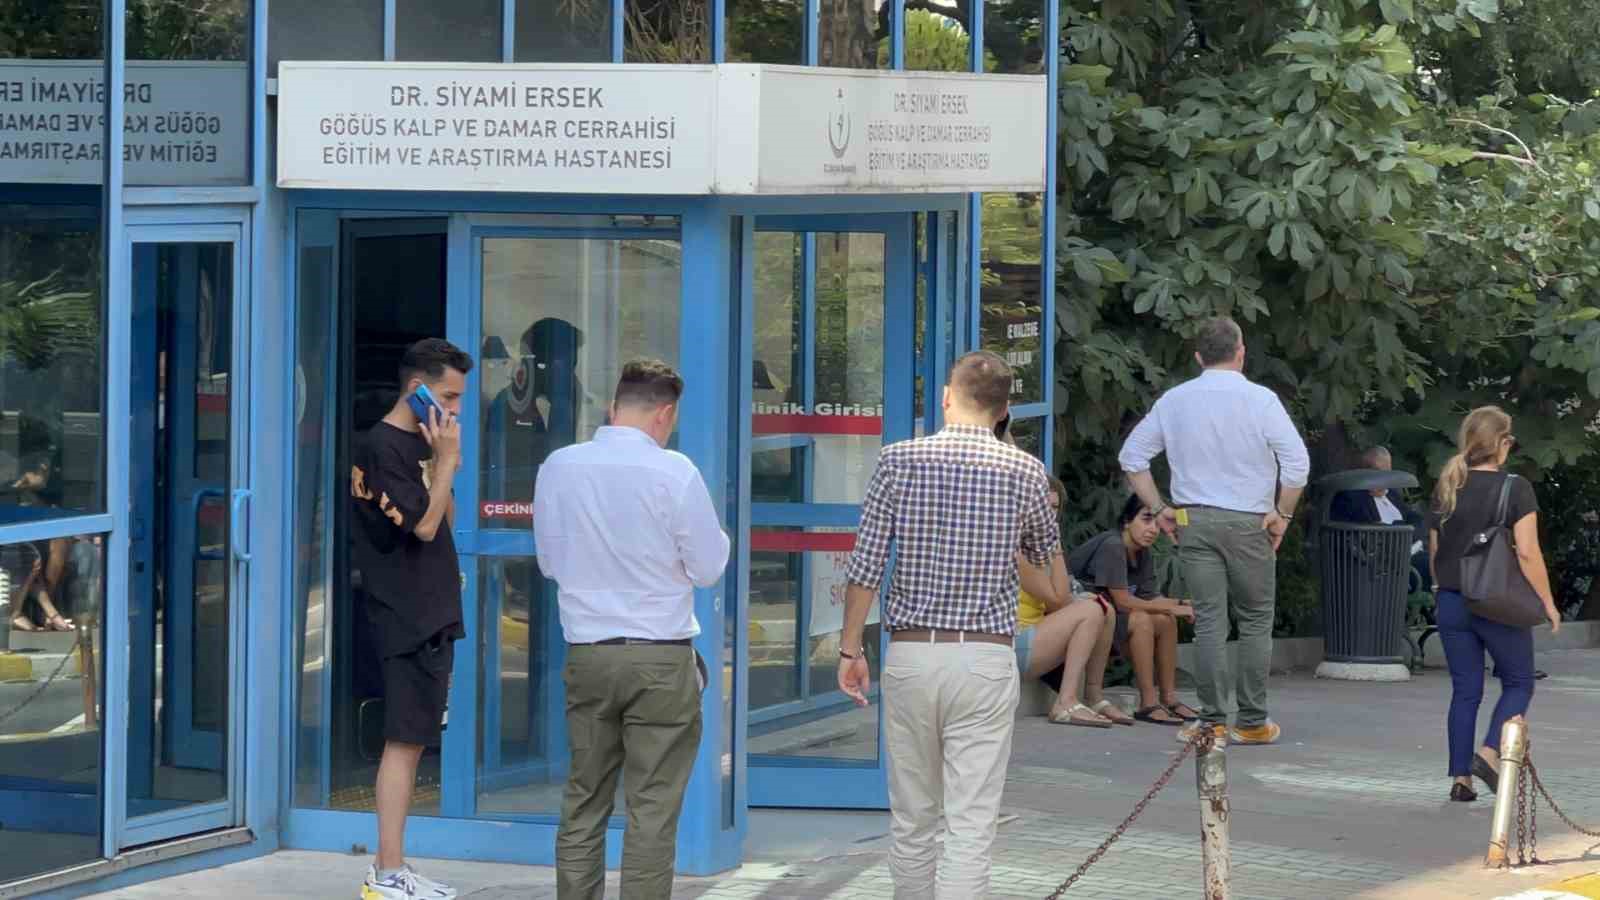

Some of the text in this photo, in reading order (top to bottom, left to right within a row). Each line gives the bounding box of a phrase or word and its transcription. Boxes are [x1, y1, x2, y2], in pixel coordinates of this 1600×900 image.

[391, 81, 604, 108] DR. SİYAMİ ERSEK
[320, 113, 675, 139] GÖĞÜS KALP VE DAMAR CERRAHİSİ
[323, 142, 671, 171] EĞİTİM VE ARAŞTIRMA HASTANESİ
